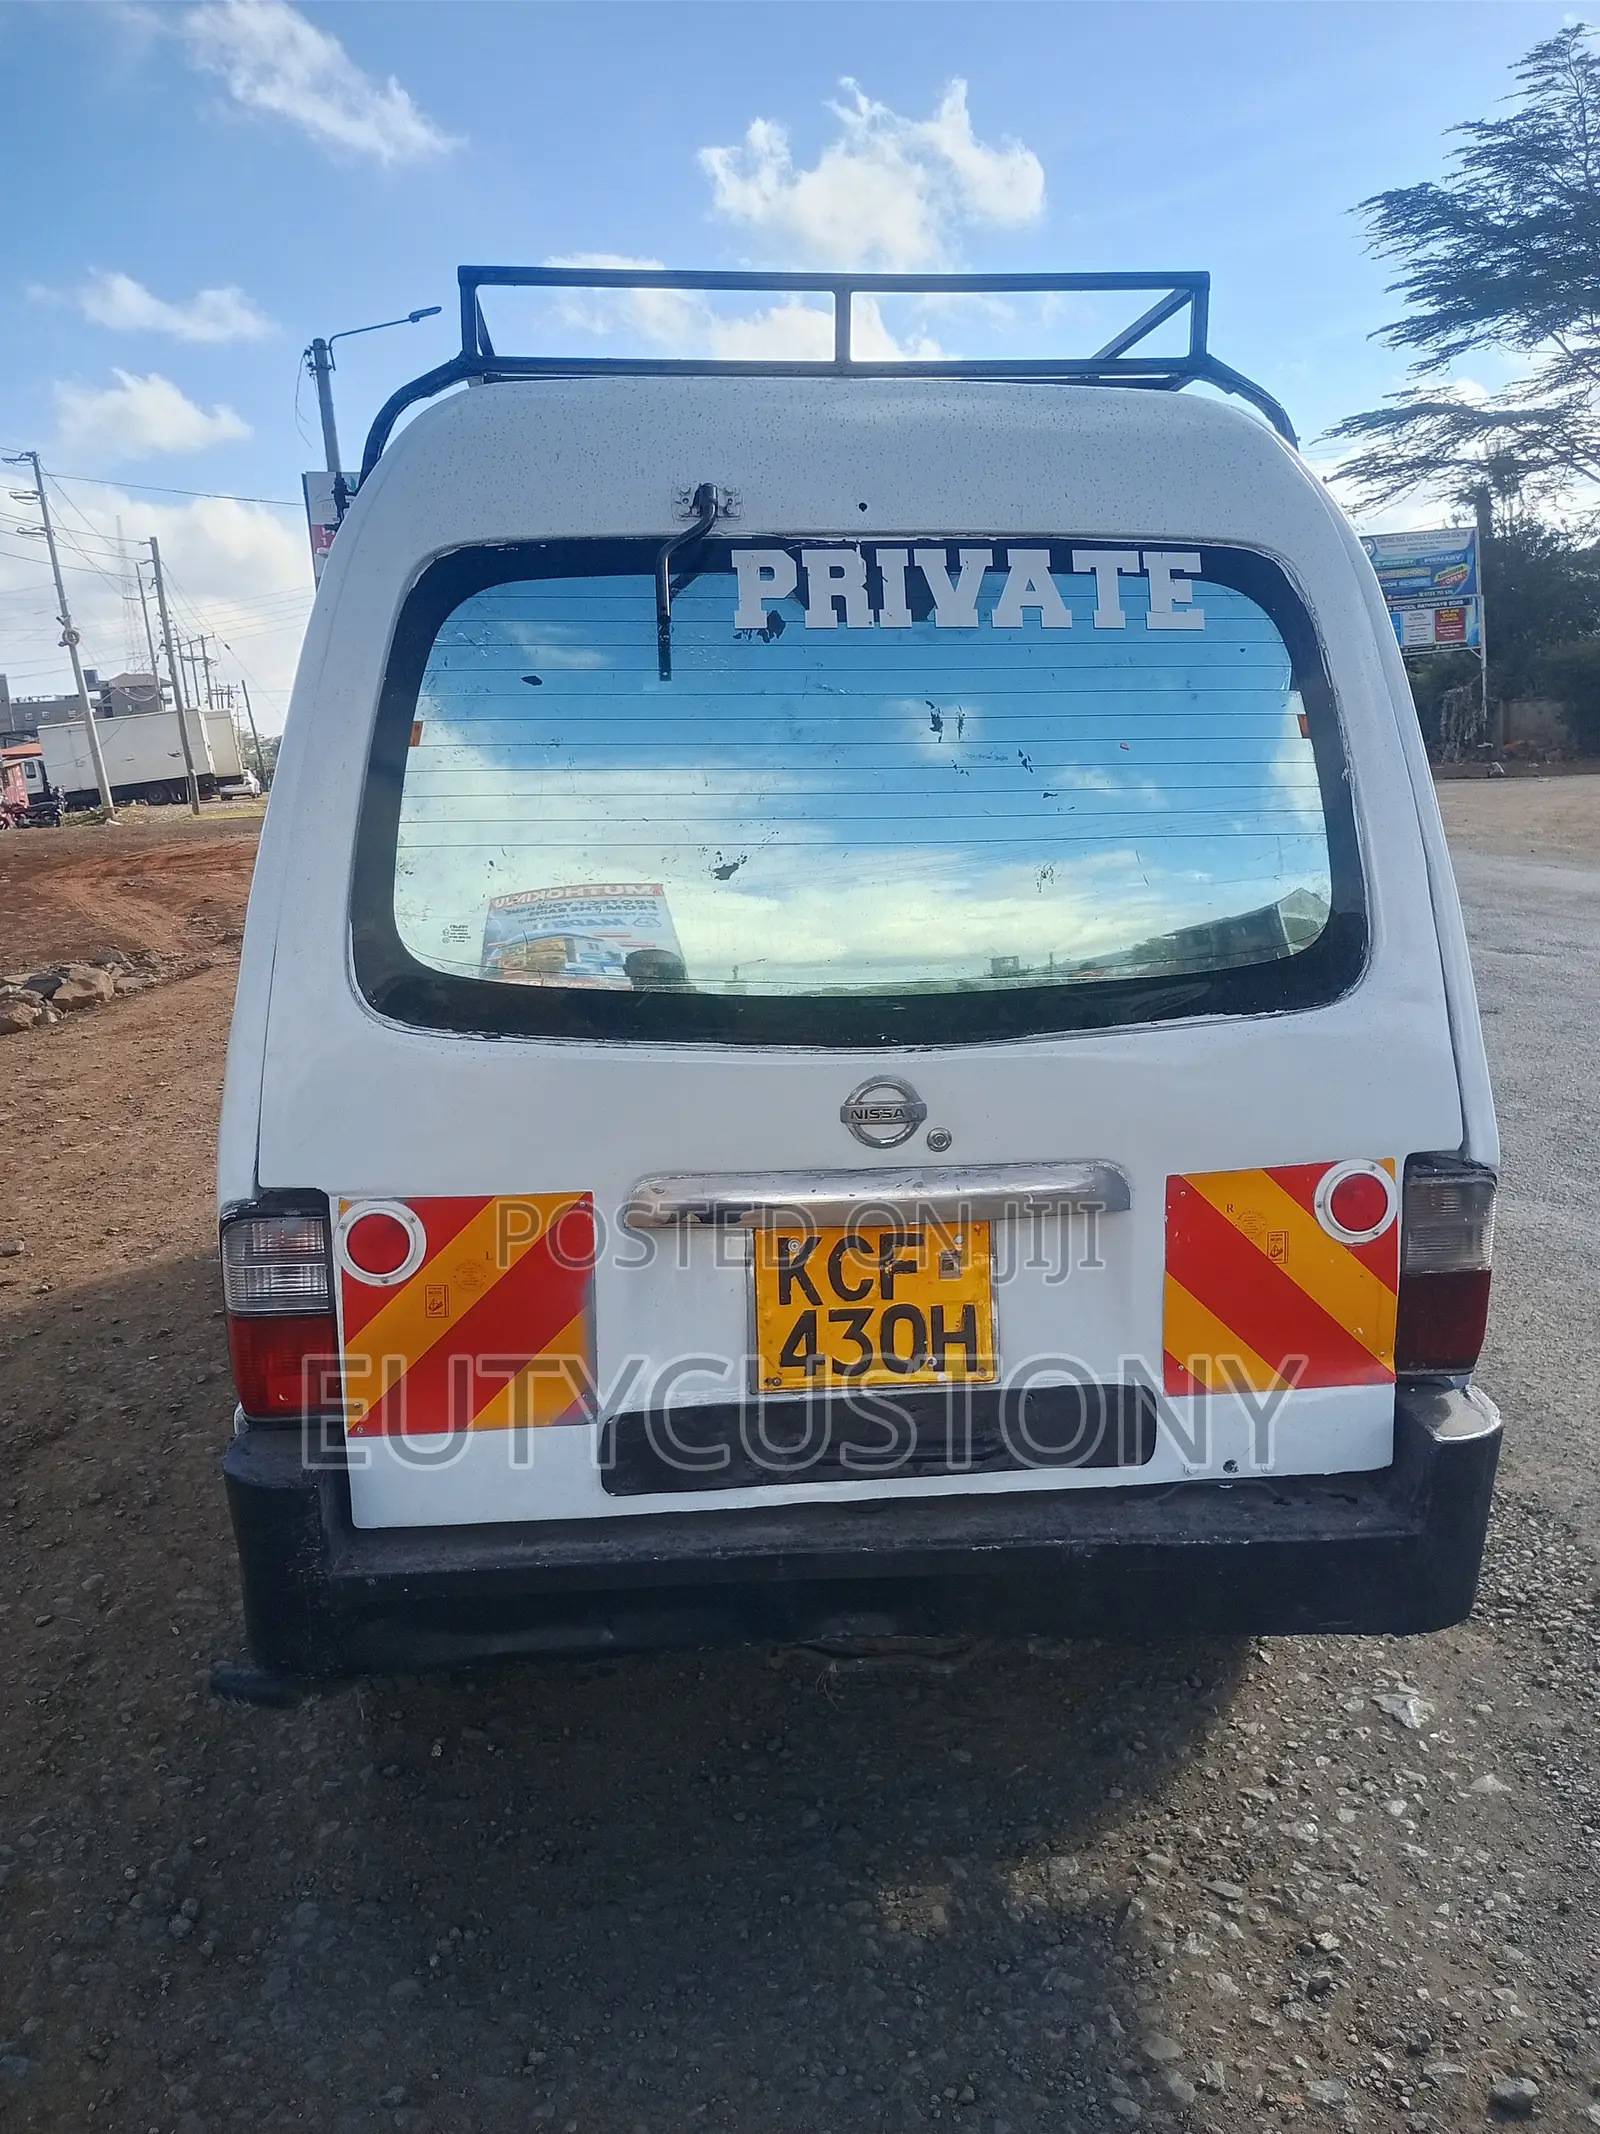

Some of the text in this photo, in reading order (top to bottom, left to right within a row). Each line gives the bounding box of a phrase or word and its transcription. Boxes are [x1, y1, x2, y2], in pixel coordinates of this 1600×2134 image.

[1424, 554, 1460, 563] PRIMARY
[1445, 574, 1464, 584] OPEN
[731, 549, 1204, 629] PRIVATE
[1226, 1203, 1235, 1213] R
[777, 1232, 925, 1306] KCF
[779, 1303, 978, 1378] 430H
